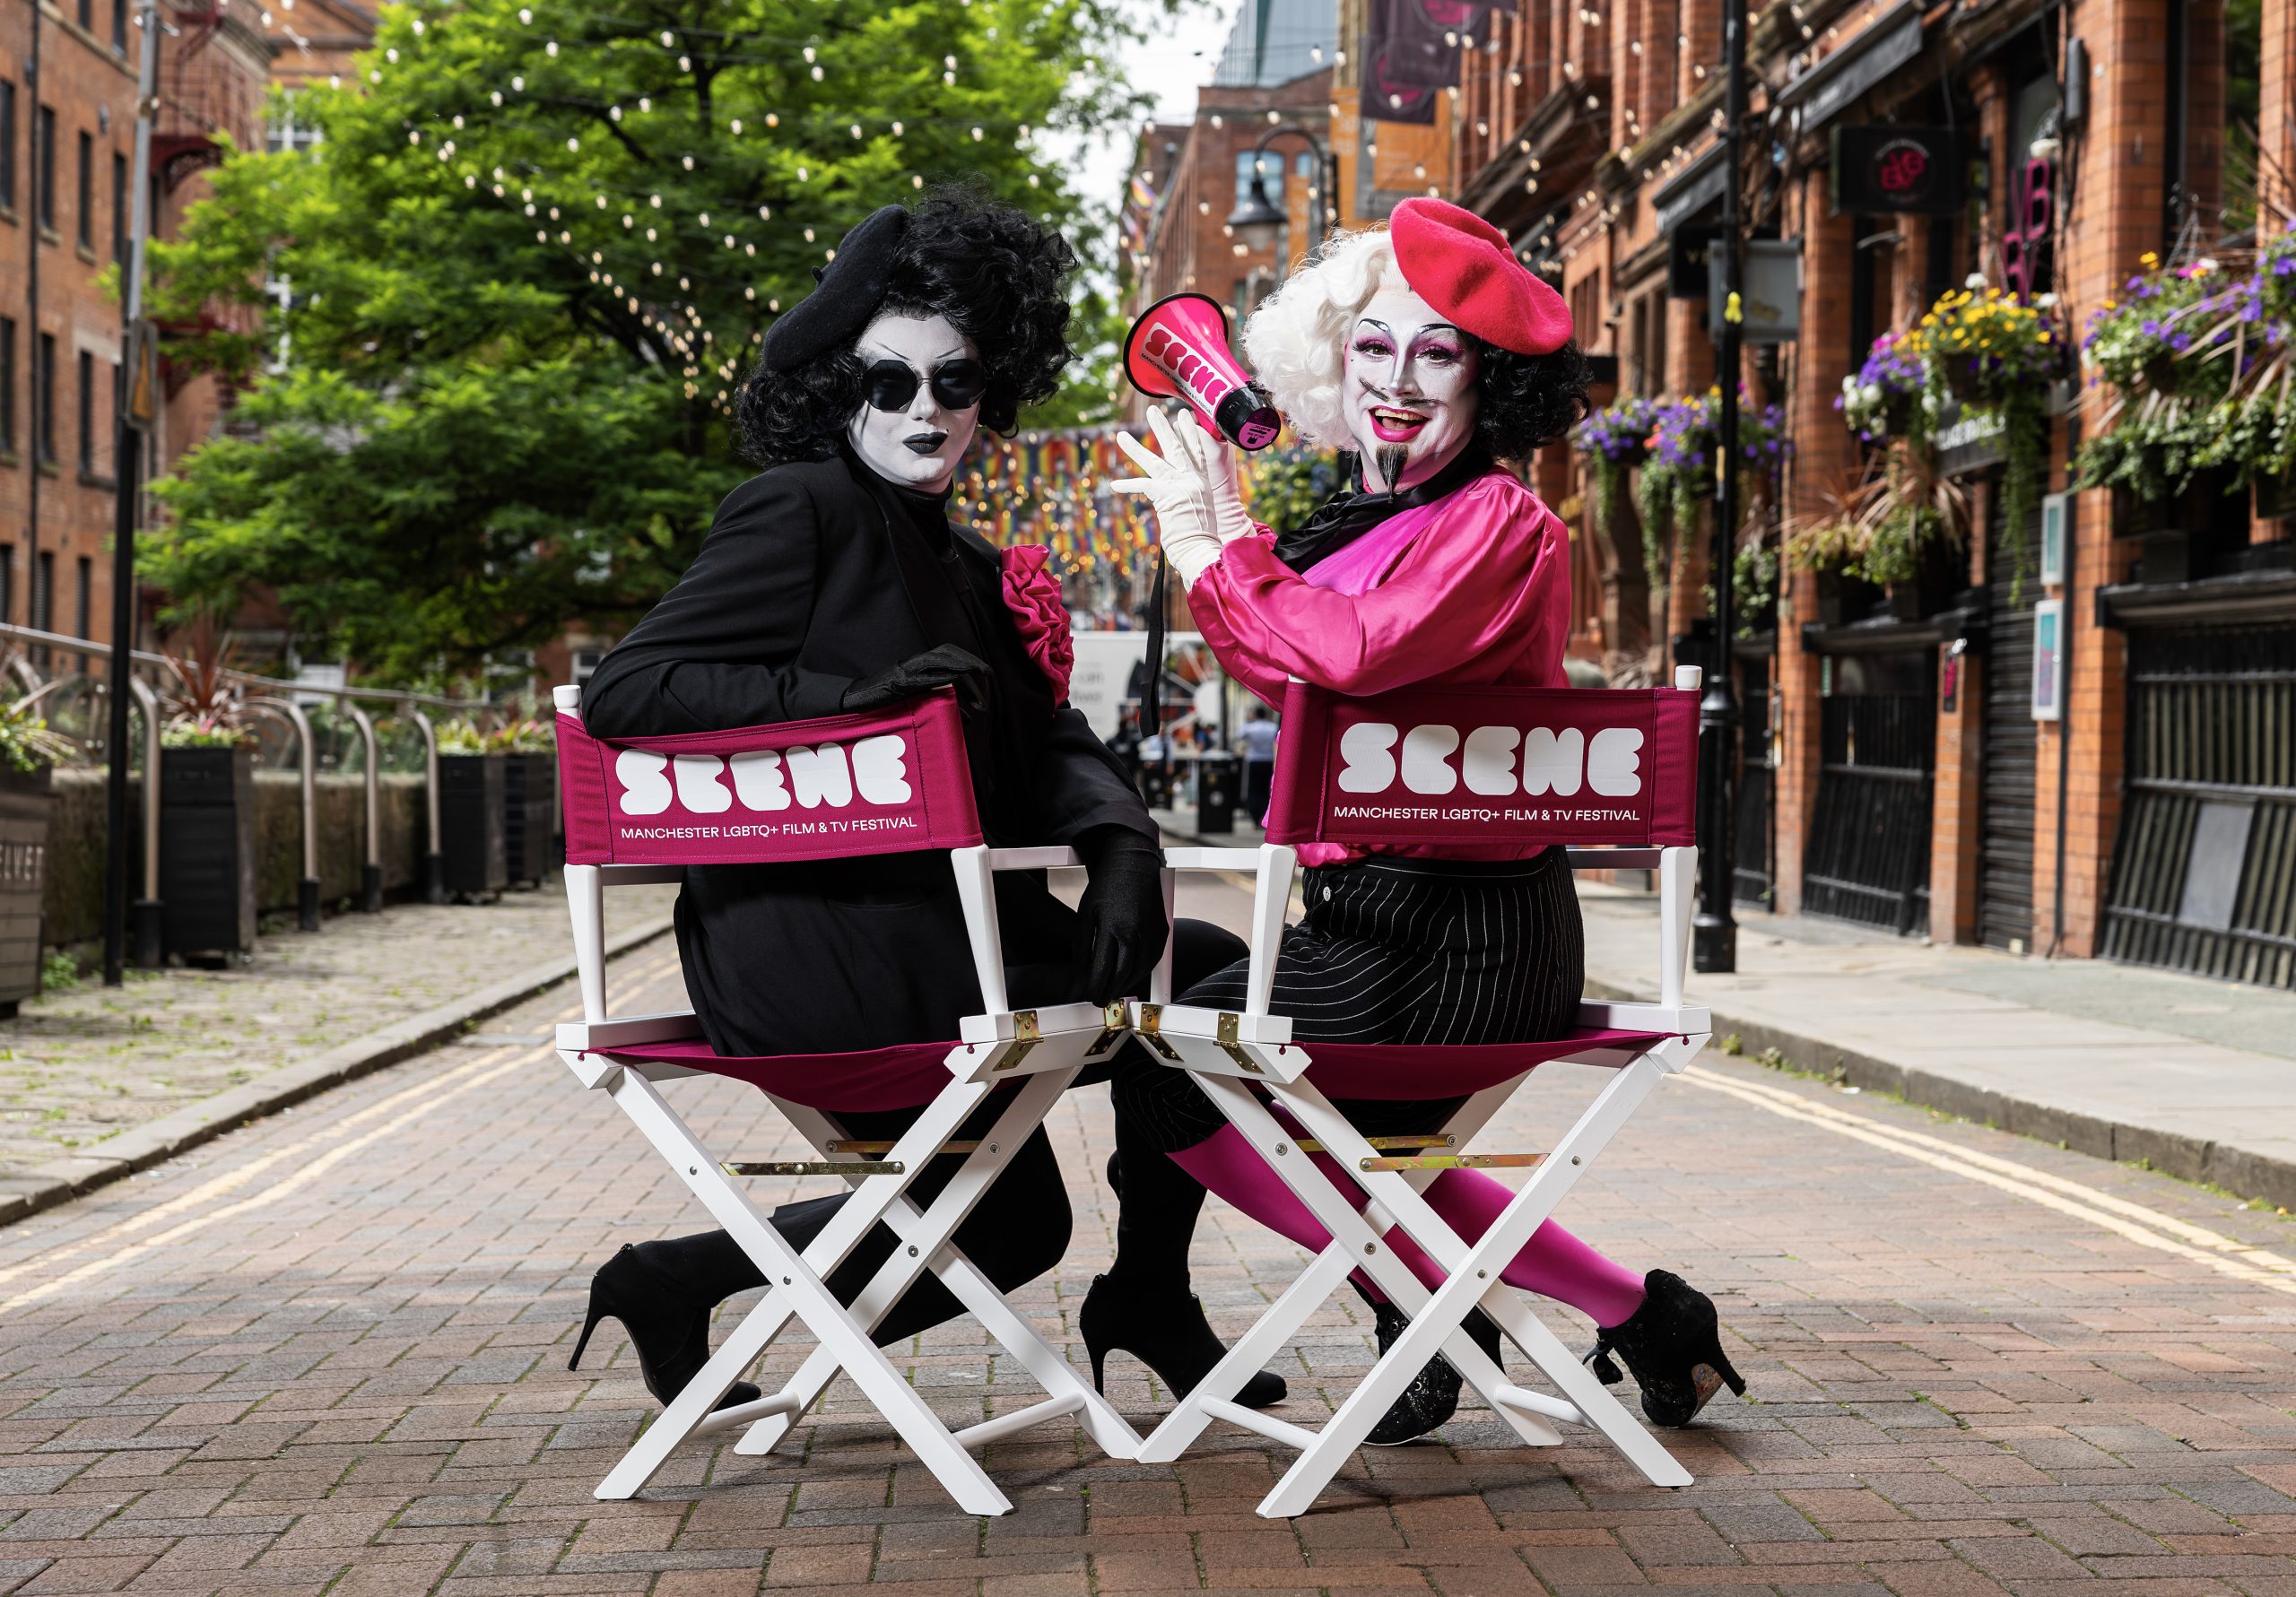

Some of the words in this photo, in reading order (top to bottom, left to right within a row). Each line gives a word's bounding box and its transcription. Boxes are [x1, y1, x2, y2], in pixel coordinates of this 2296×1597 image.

[1145, 329, 1227, 406] SCENE
[615, 734, 912, 816] SCENE
[1338, 722, 1645, 797] SCENE
[621, 826, 720, 839] MANCHESTER
[723, 824, 779, 838] LGBTQ+
[782, 822, 815, 836] FILM
[818, 821, 828, 834] &
[829, 820, 848, 833] TV
[851, 816, 918, 831] FESTIVAL
[1334, 806, 1439, 820] MANCHESTER
[1442, 808, 1500, 821] LGBTQ+
[1504, 809, 1538, 820] FILM
[1541, 809, 1551, 820] &
[1552, 810, 1573, 821] TV
[1575, 810, 1640, 821] FESTIVAL
